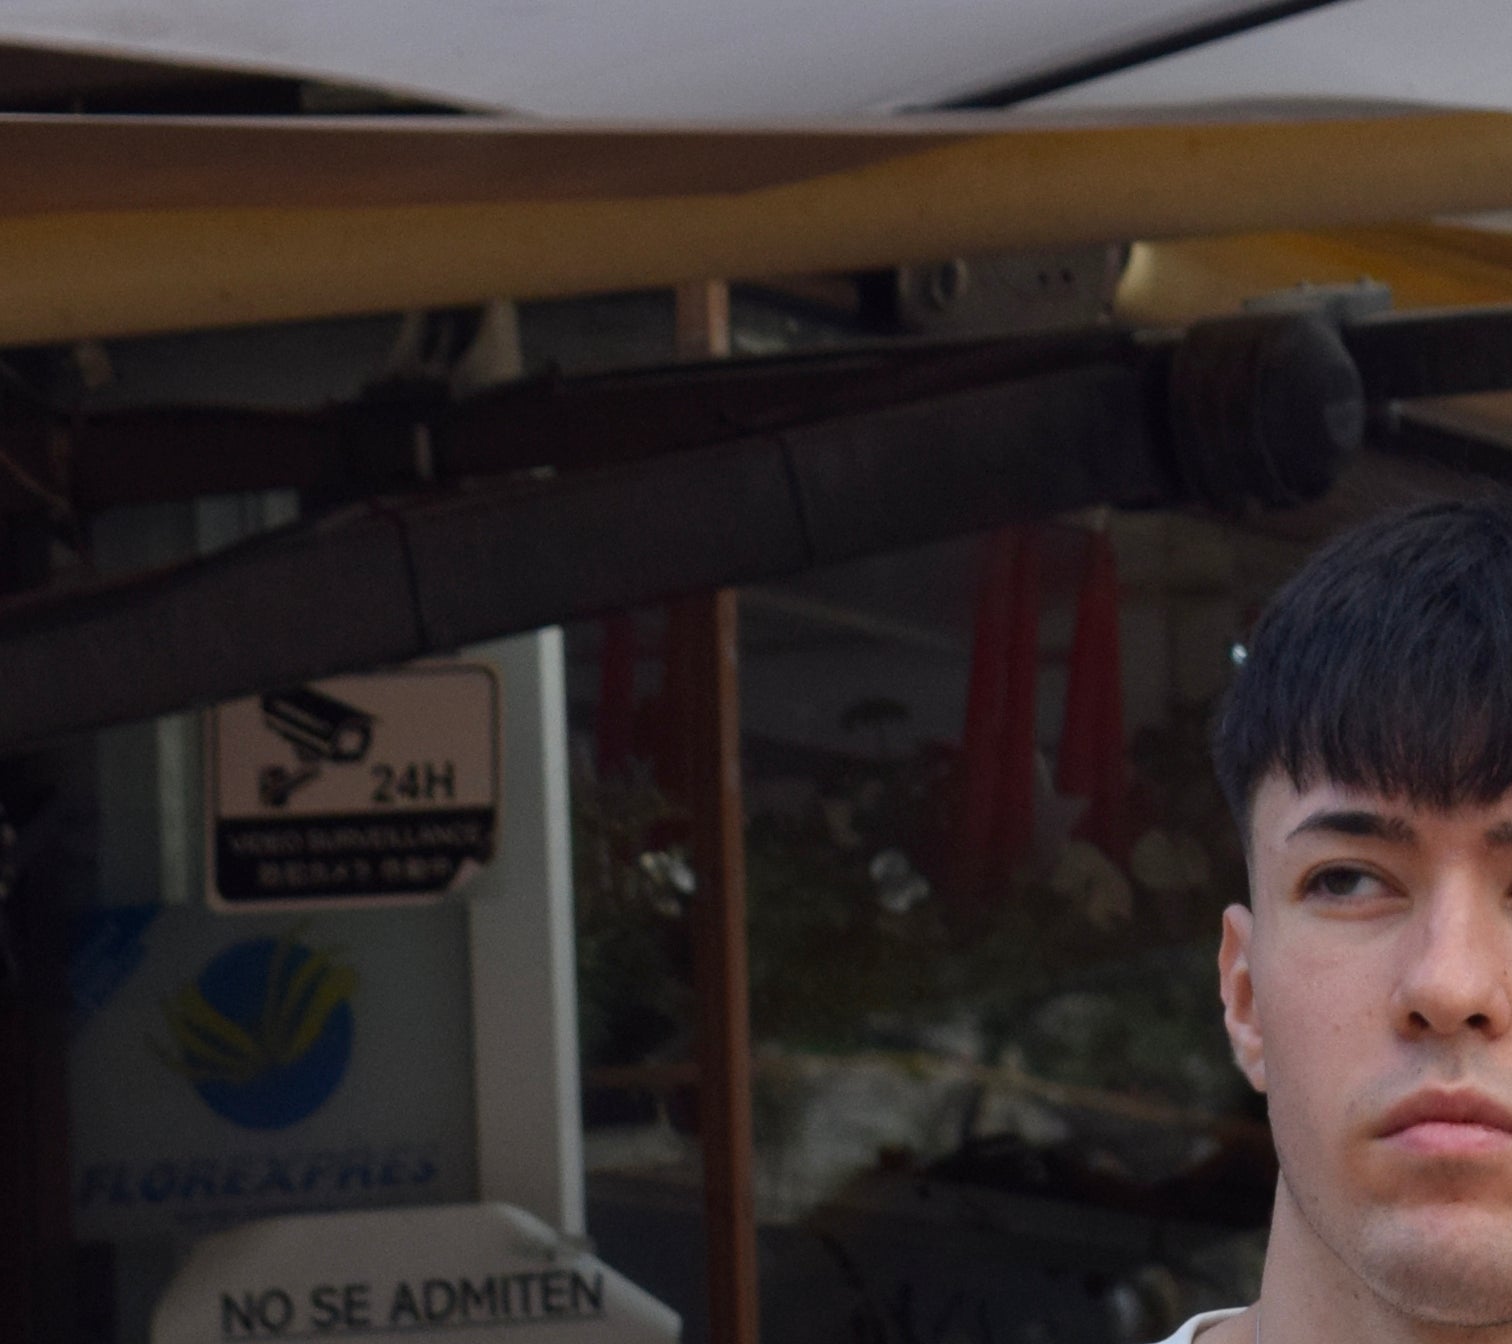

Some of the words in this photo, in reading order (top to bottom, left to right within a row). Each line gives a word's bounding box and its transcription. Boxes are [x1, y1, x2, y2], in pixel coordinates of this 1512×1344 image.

[372, 761, 454, 803] 24H
[220, 1287, 296, 1336] NO
[310, 1283, 372, 1331] SE
[389, 1269, 606, 1327] ADMITEN
